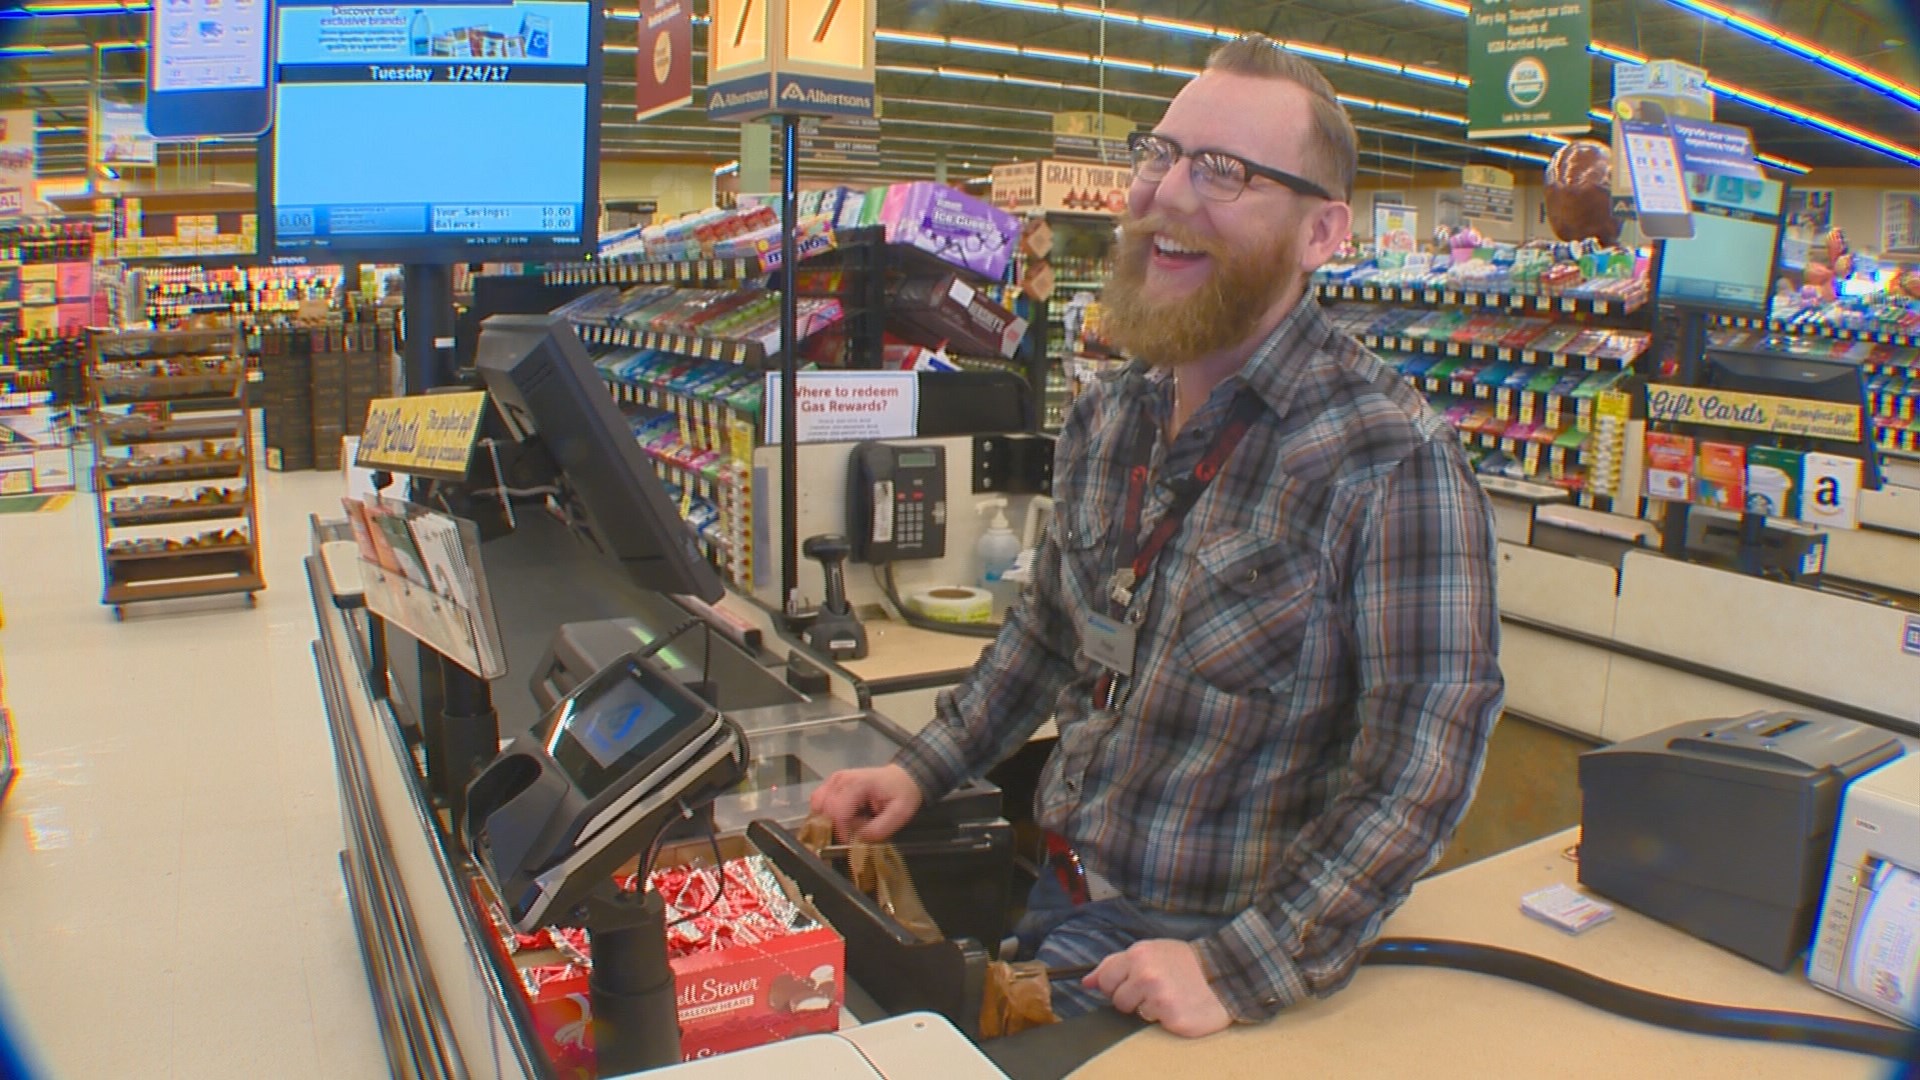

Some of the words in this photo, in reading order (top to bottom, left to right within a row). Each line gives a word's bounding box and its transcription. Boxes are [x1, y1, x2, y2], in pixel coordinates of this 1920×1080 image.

[370, 66, 433, 82] Tuesday
[446, 66, 510, 82] 1/24/17
[726, 88, 769, 106] Albertsons
[806, 89, 871, 109] Albertsons
[1047, 165, 1083, 186] CRAFT
[1085, 168, 1114, 188] YOUR
[436, 207, 458, 217] Your
[464, 207, 511, 220] Savings:
[542, 207, 571, 218] $0.00
[436, 219, 481, 230] Balance:
[542, 218, 571, 229] $0.00
[271, 254, 307, 265] Lenovo
[835, 387, 850, 398] to
[852, 385, 899, 398] redeem
[801, 402, 825, 414] Gas
[829, 400, 889, 414] Rewards?
[1649, 389, 1695, 422] Gift
[1697, 395, 1764, 424] Cards
[1815, 475, 1840, 506] a
[700, 978, 759, 1002] Stover
